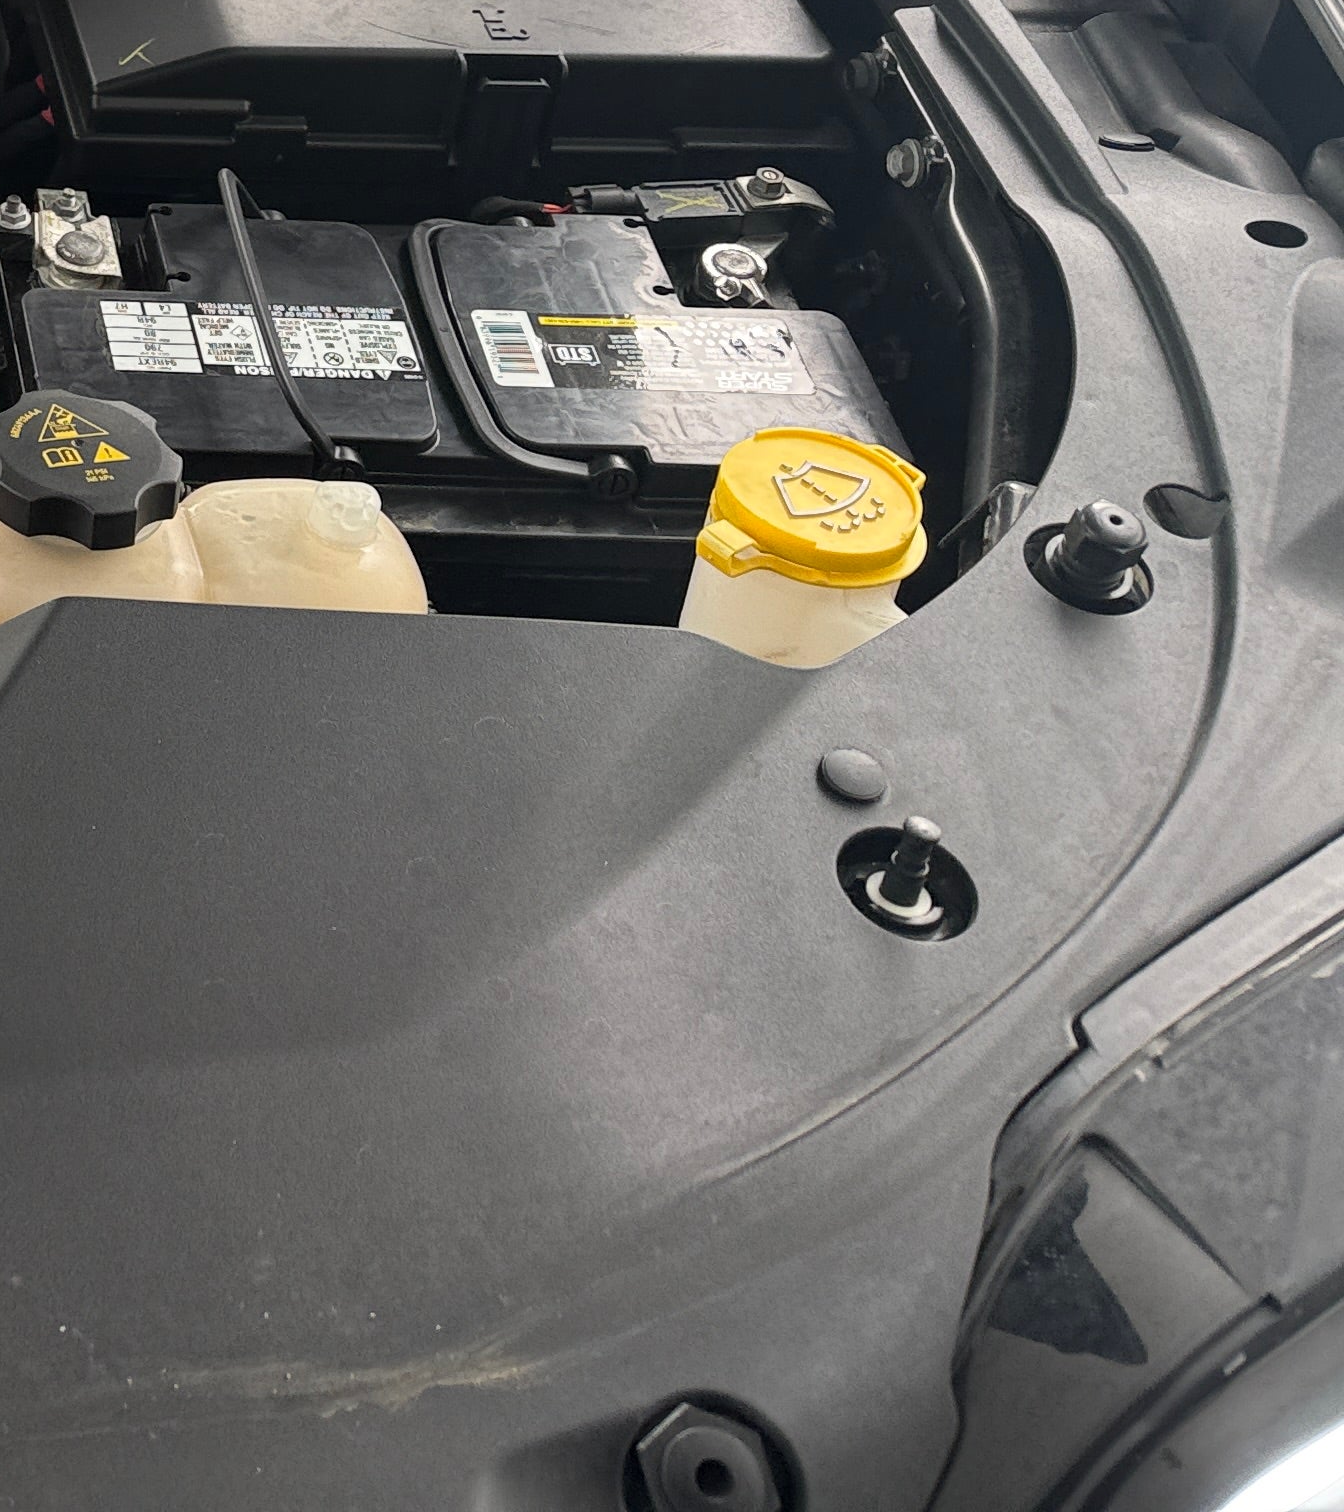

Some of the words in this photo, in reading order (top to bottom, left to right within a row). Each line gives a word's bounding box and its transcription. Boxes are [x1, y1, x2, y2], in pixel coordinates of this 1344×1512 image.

[555, 346, 594, 362] STD
[715, 371, 793, 383] START
[716, 380, 788, 392] SUPER
